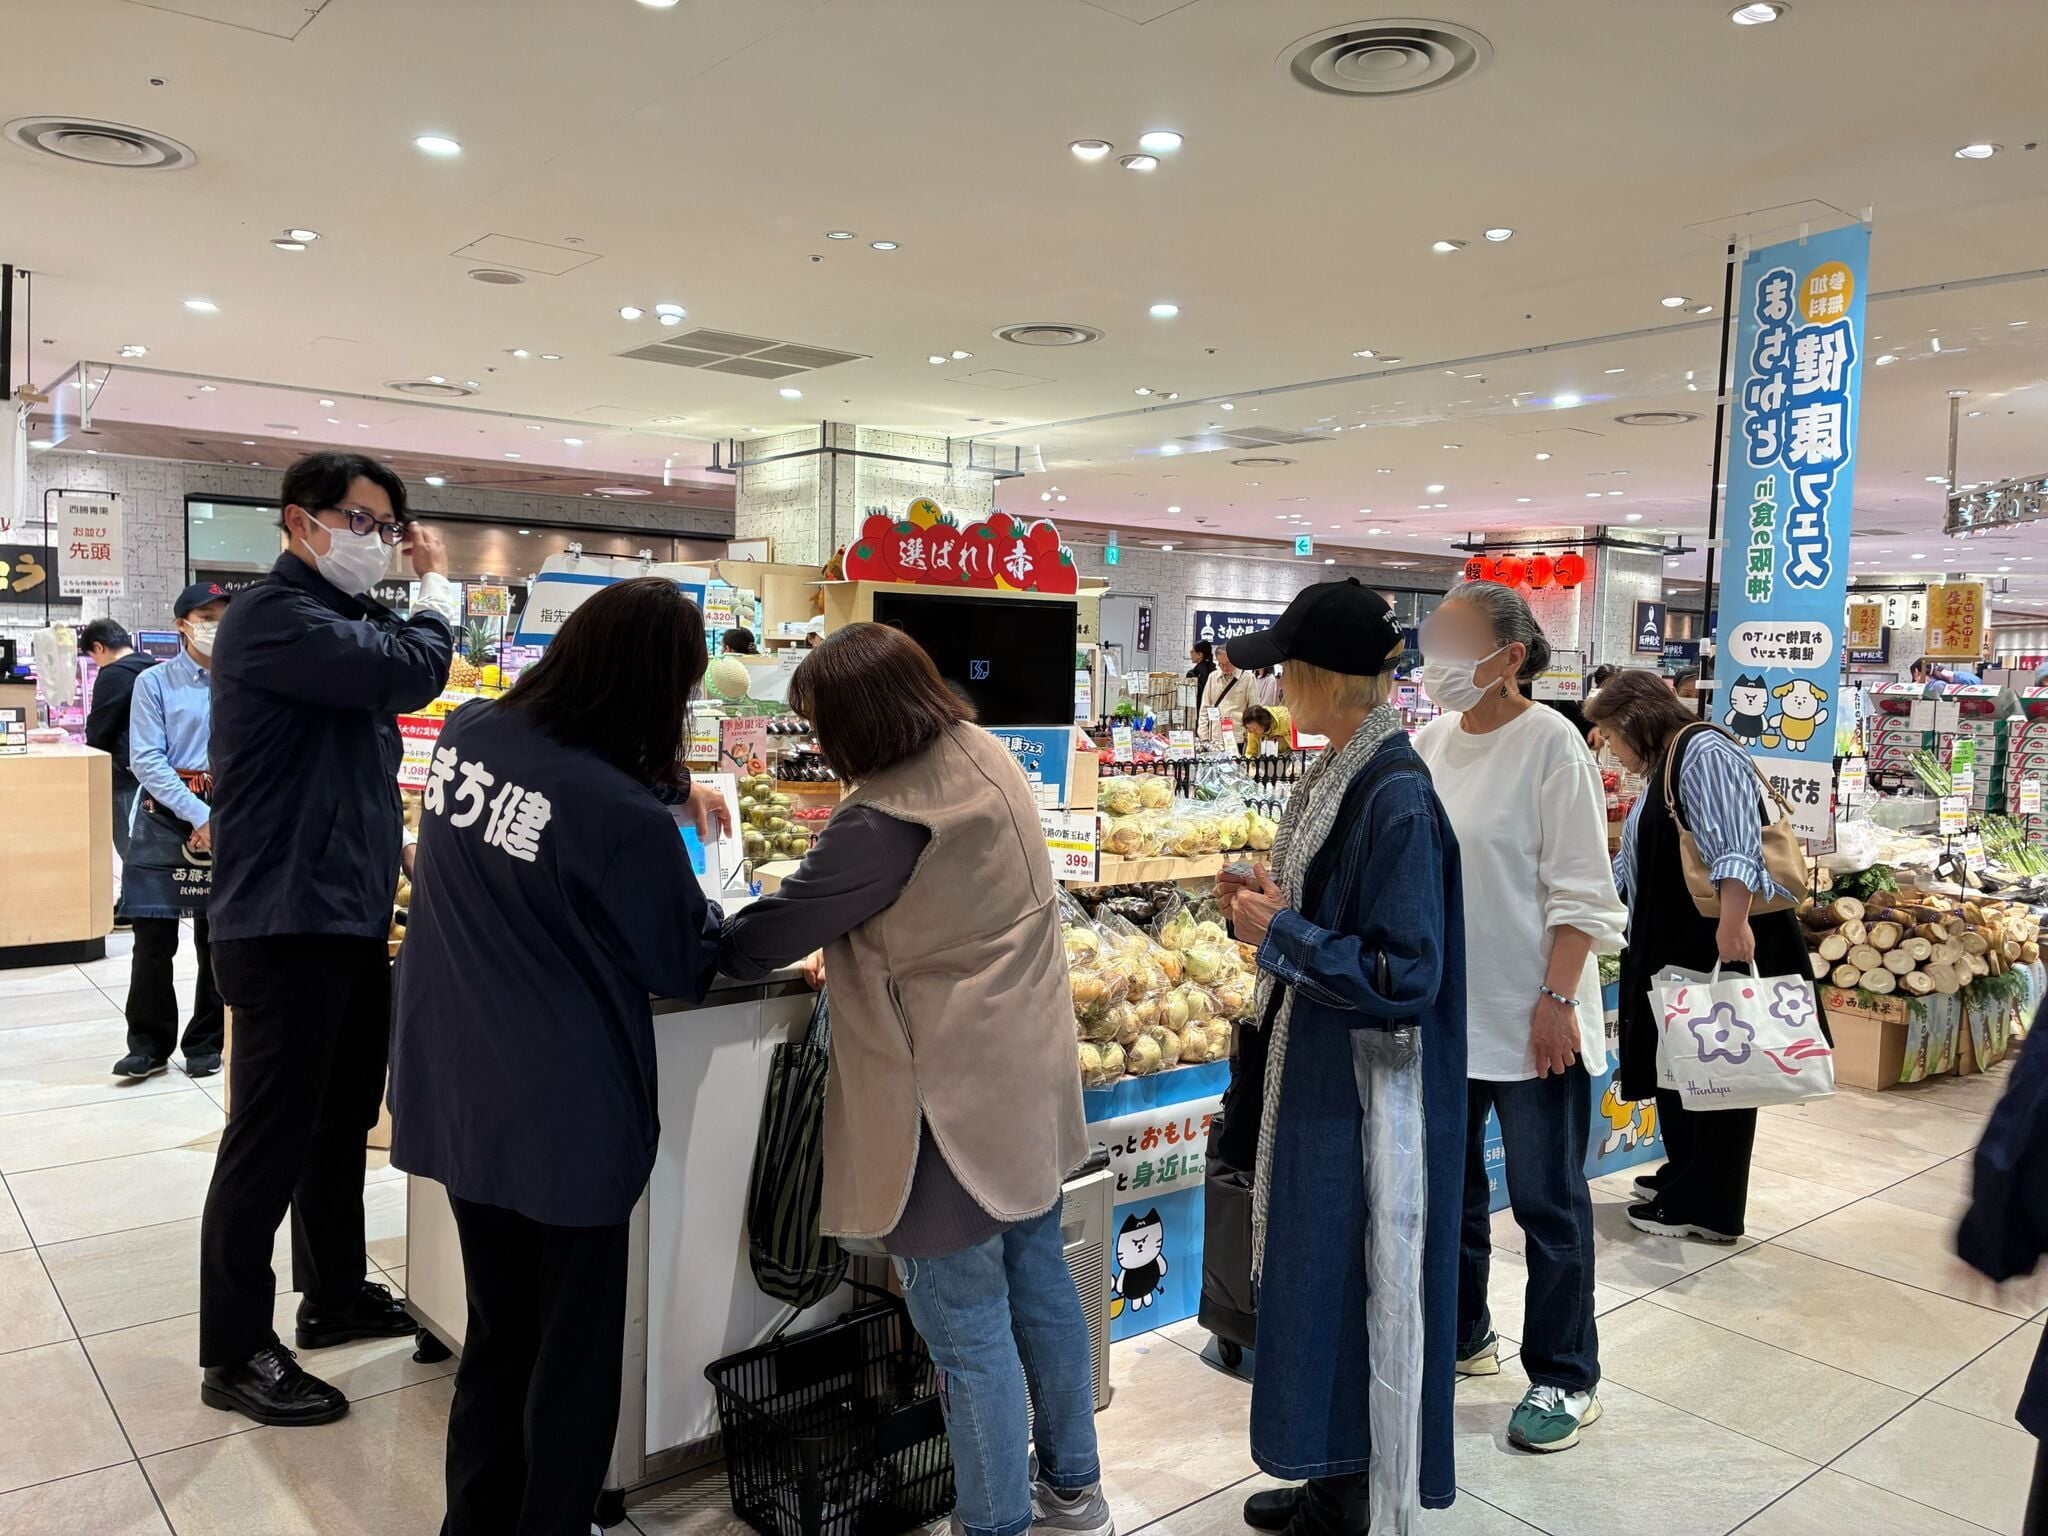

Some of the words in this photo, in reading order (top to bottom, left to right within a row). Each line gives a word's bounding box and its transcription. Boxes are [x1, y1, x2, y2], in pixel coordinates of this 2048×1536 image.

[73, 527, 107, 537] お並び
[69, 541, 111, 561] 先頭
[899, 537, 1034, 580] 選ばれし赤
[540, 608, 573, 624] 指先
[424, 746, 551, 862] まち健
[1686, 1079, 1732, 1098] Hankyu
[1099, 1114, 1212, 1157] っとおもしろ
[1116, 1153, 1206, 1191] と身近に。
